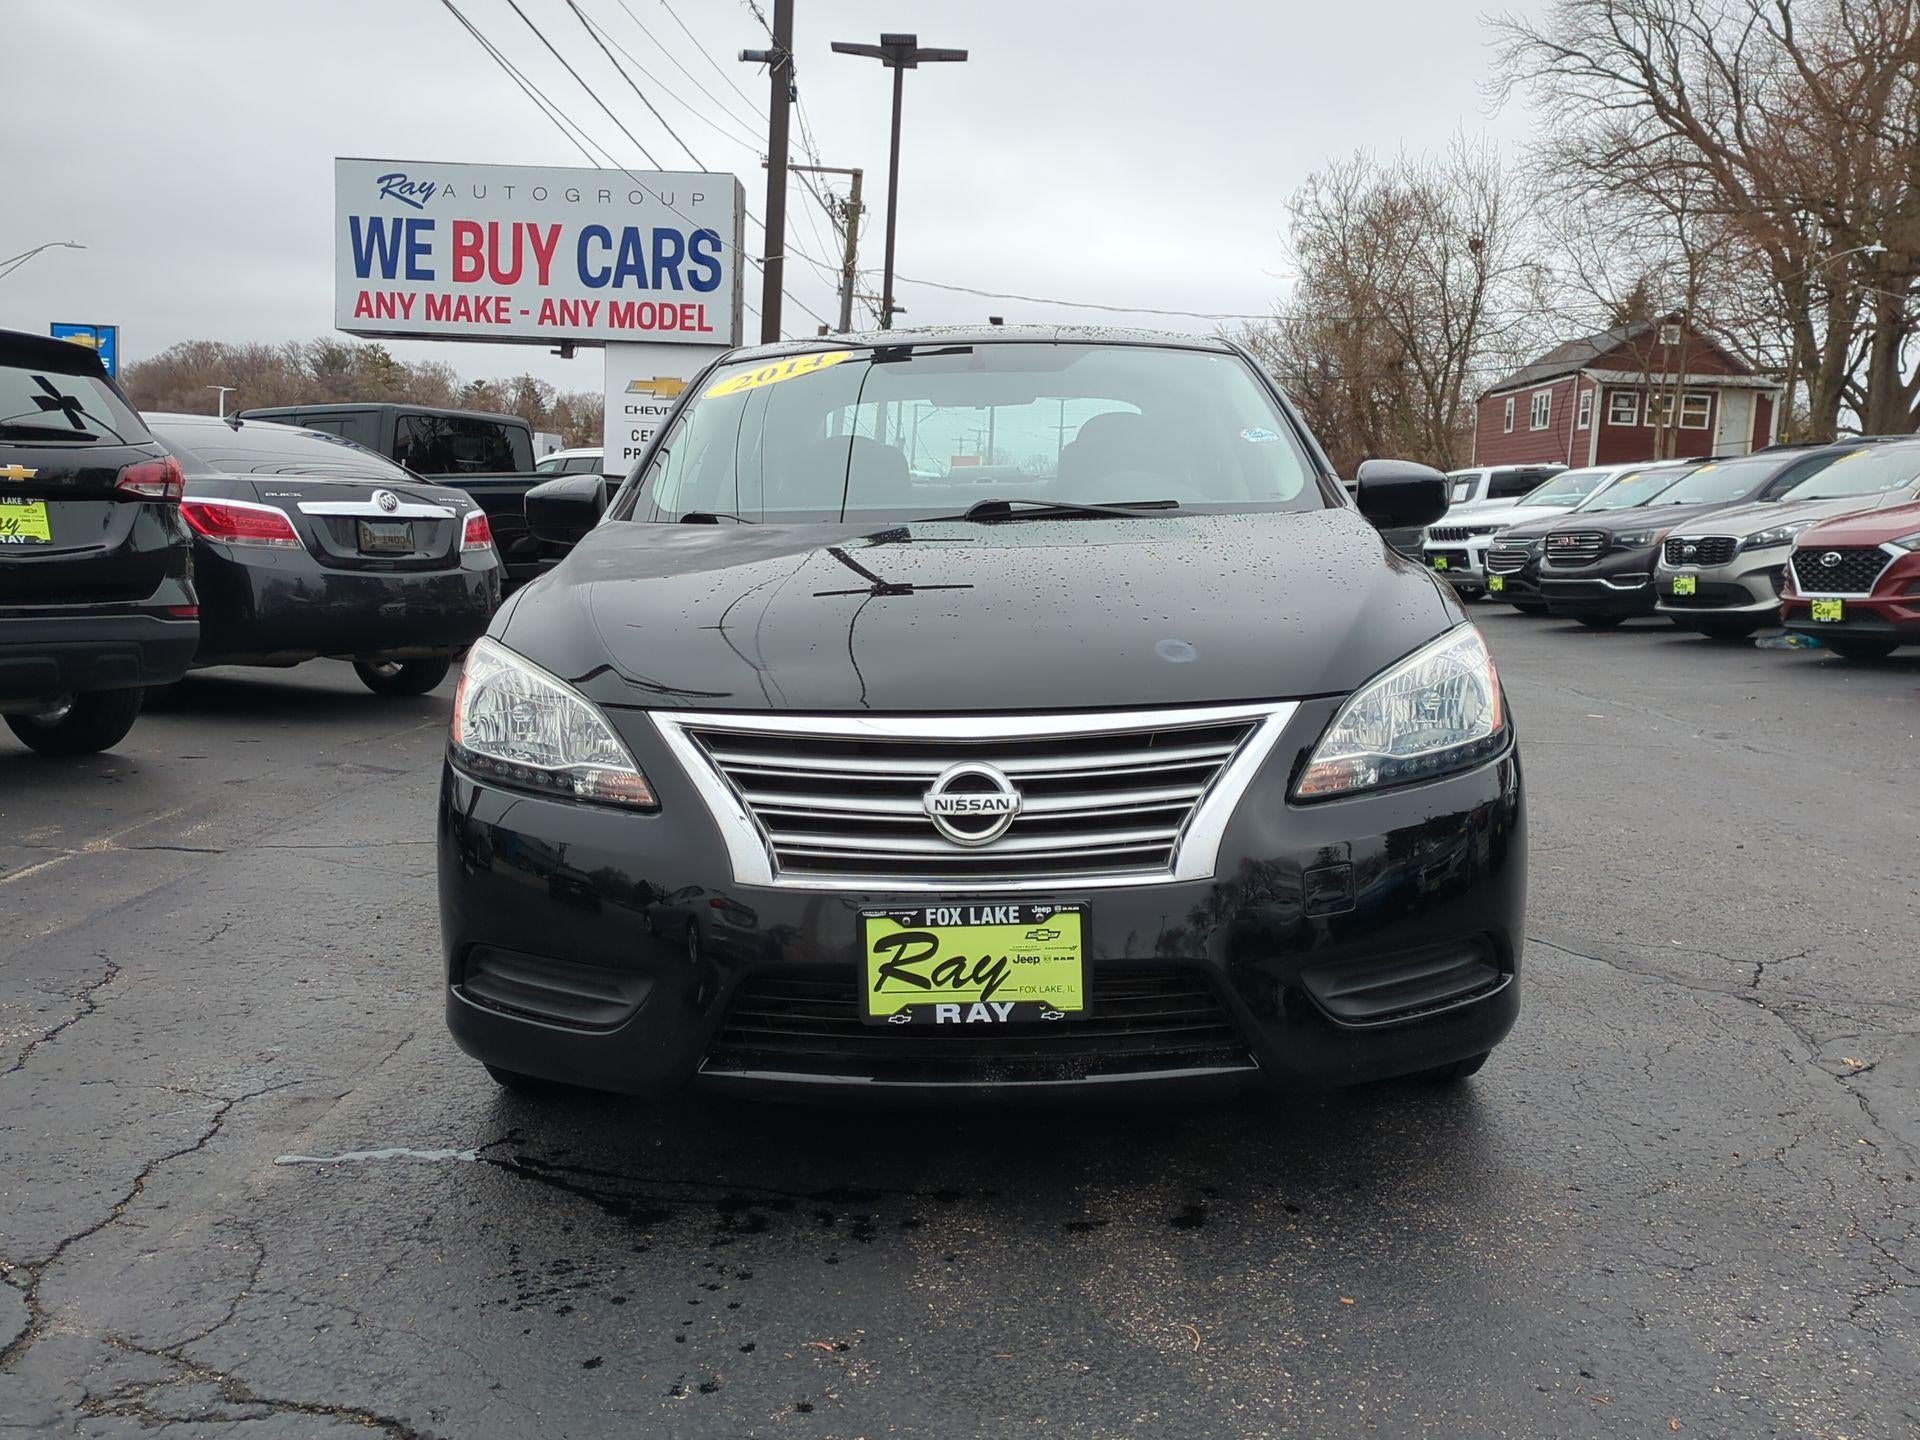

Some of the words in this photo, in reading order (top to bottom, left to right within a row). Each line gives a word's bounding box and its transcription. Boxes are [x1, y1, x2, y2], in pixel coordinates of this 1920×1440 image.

[377, 173, 438, 210] Ray
[349, 215, 436, 282] WE
[452, 220, 563, 287] BUY
[577, 224, 722, 293] CARS
[354, 290, 417, 320] ANY
[425, 293, 512, 324] MAKE
[538, 298, 600, 328] ANY
[608, 300, 714, 332] MODEL
[732, 355, 825, 391] 2014
[2, 497, 22, 505] LAKE
[935, 799, 1010, 811] NISSAN
[926, 907, 964, 926] FOX
[969, 906, 1020, 925] LAKE
[1031, 905, 1052, 914] Jeep
[873, 931, 1011, 1002] Ray
[1013, 954, 1040, 965] Jeep
[1019, 985, 1037, 994] FOX
[1039, 985, 1065, 994] LAKE,
[1067, 985, 1076, 993] IL
[936, 1002, 1016, 1024] RAY
